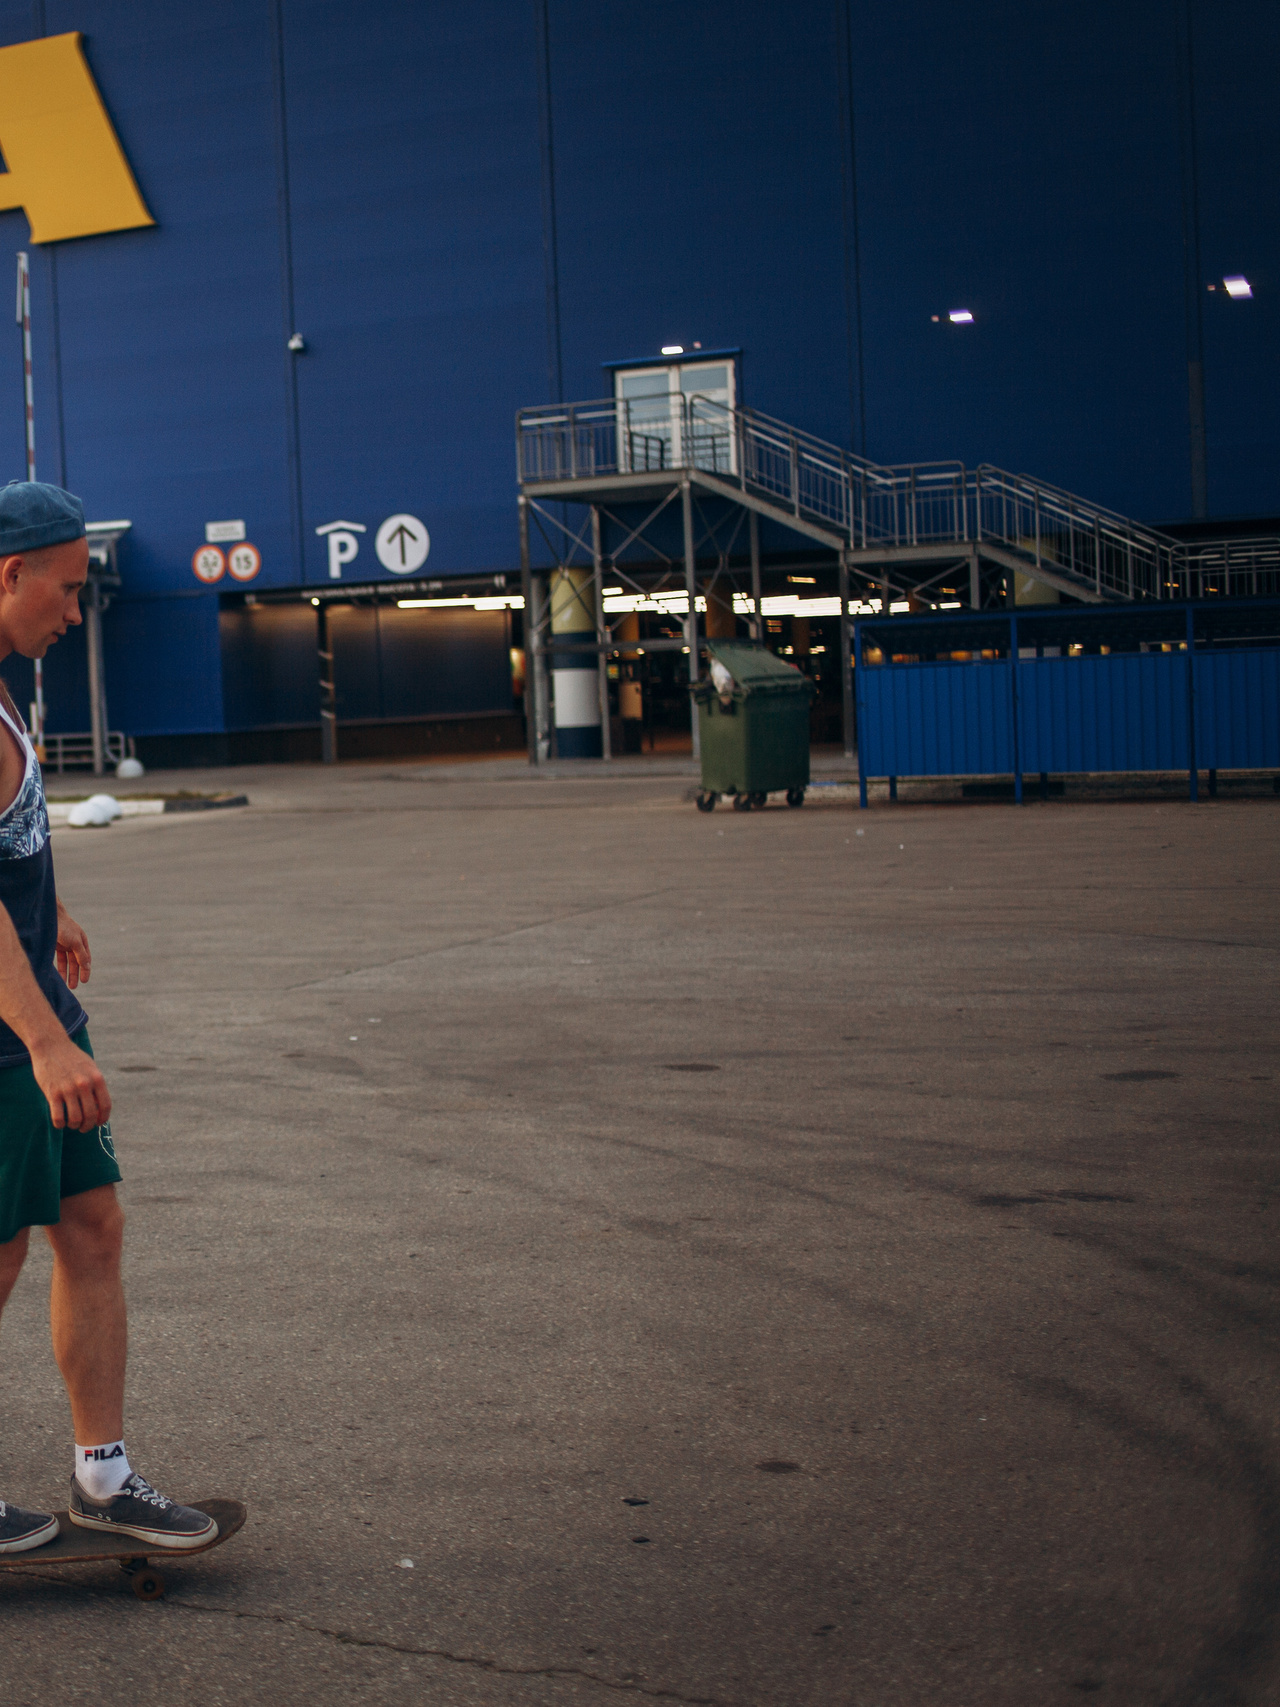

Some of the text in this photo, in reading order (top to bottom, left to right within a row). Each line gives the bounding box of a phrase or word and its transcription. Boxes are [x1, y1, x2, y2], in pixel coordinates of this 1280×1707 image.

[236, 554, 252, 570] 15
[327, 531, 359, 579] P
[84, 1444, 124, 1462] FILA
